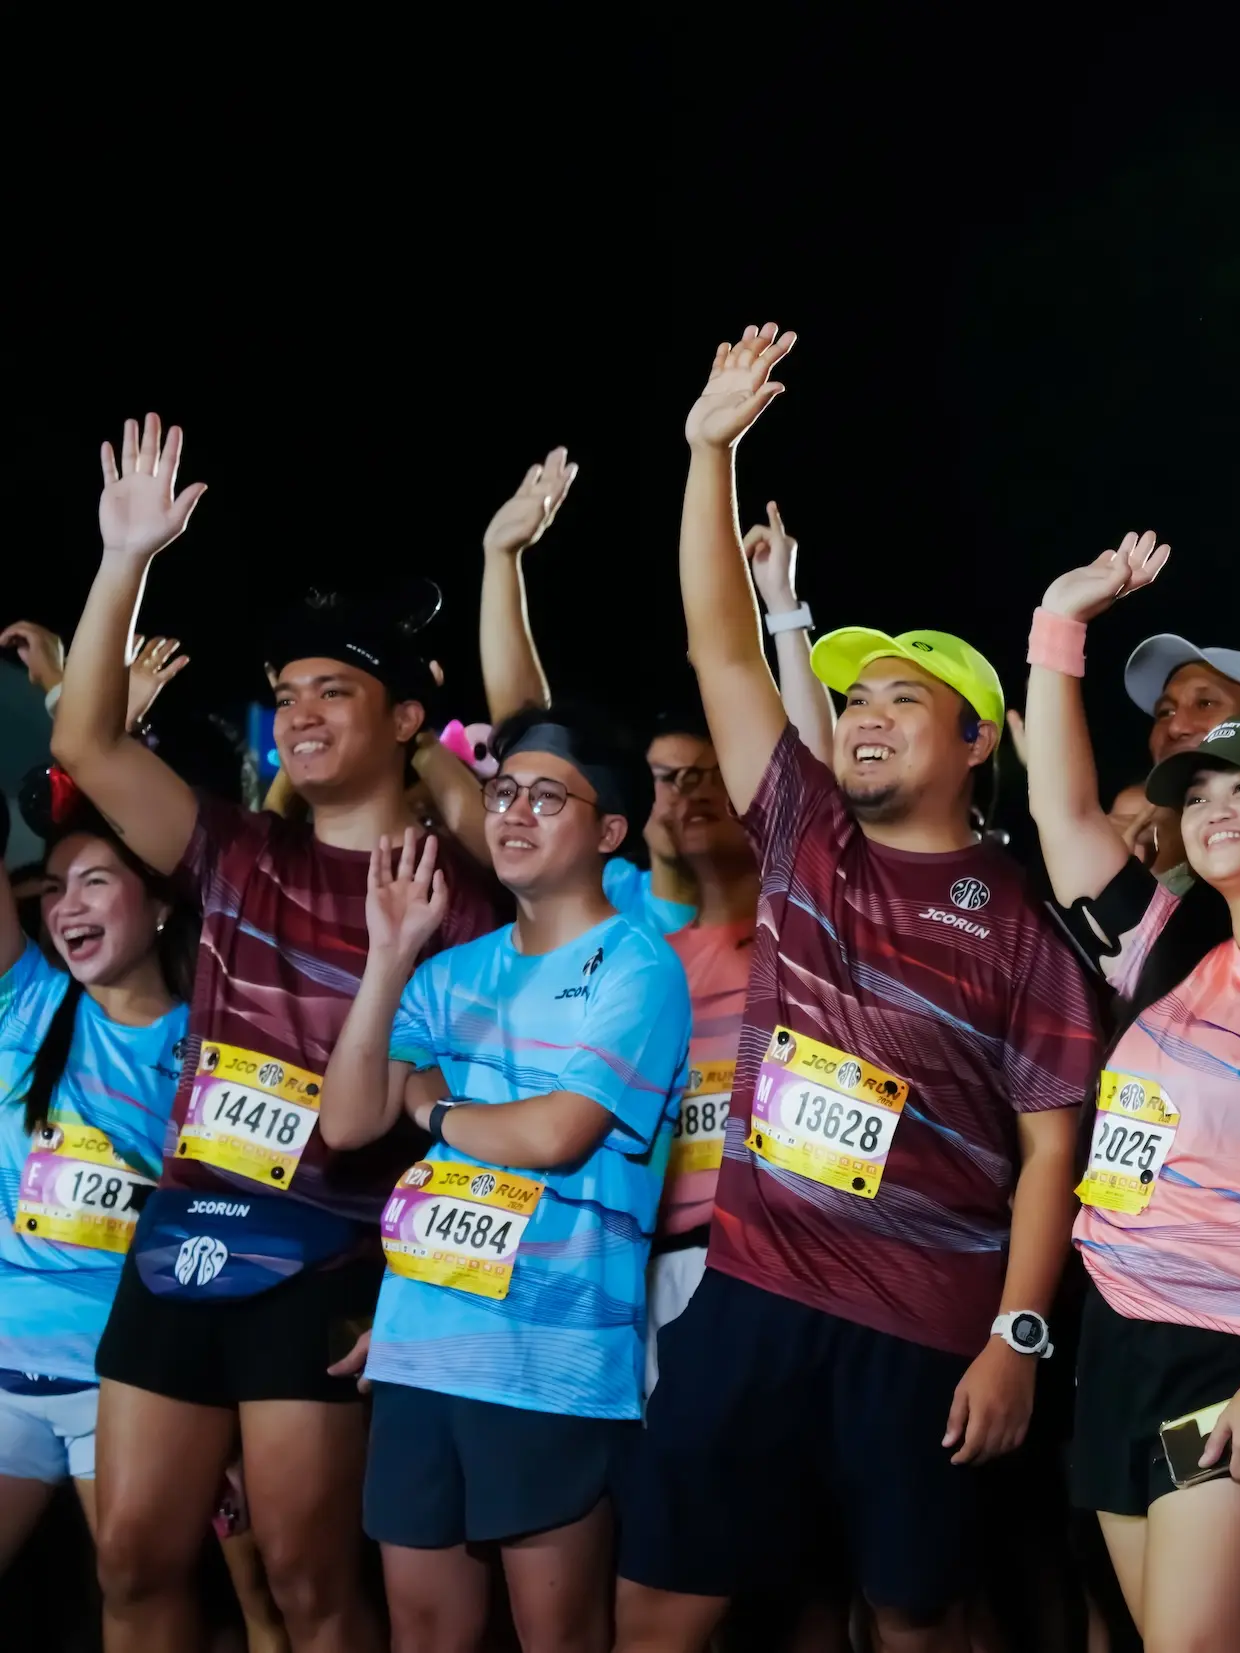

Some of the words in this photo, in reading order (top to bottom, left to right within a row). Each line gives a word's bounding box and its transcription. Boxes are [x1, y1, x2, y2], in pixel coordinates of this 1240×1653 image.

[919, 908, 990, 939] JCORUN
[225, 1058, 258, 1074] JCO
[802, 1054, 837, 1074] JCO
[757, 1074, 774, 1104] M
[214, 1091, 301, 1145] 14418
[794, 1091, 883, 1153] 13628
[72, 1137, 110, 1152] JCO
[27, 1162, 43, 1187] F
[404, 1168, 432, 1186] 12K
[438, 1173, 470, 1186] JCO
[496, 1184, 534, 1202] RUN
[187, 1200, 250, 1217] JCORUN
[385, 1198, 407, 1224] M
[425, 1204, 513, 1255] 14584
